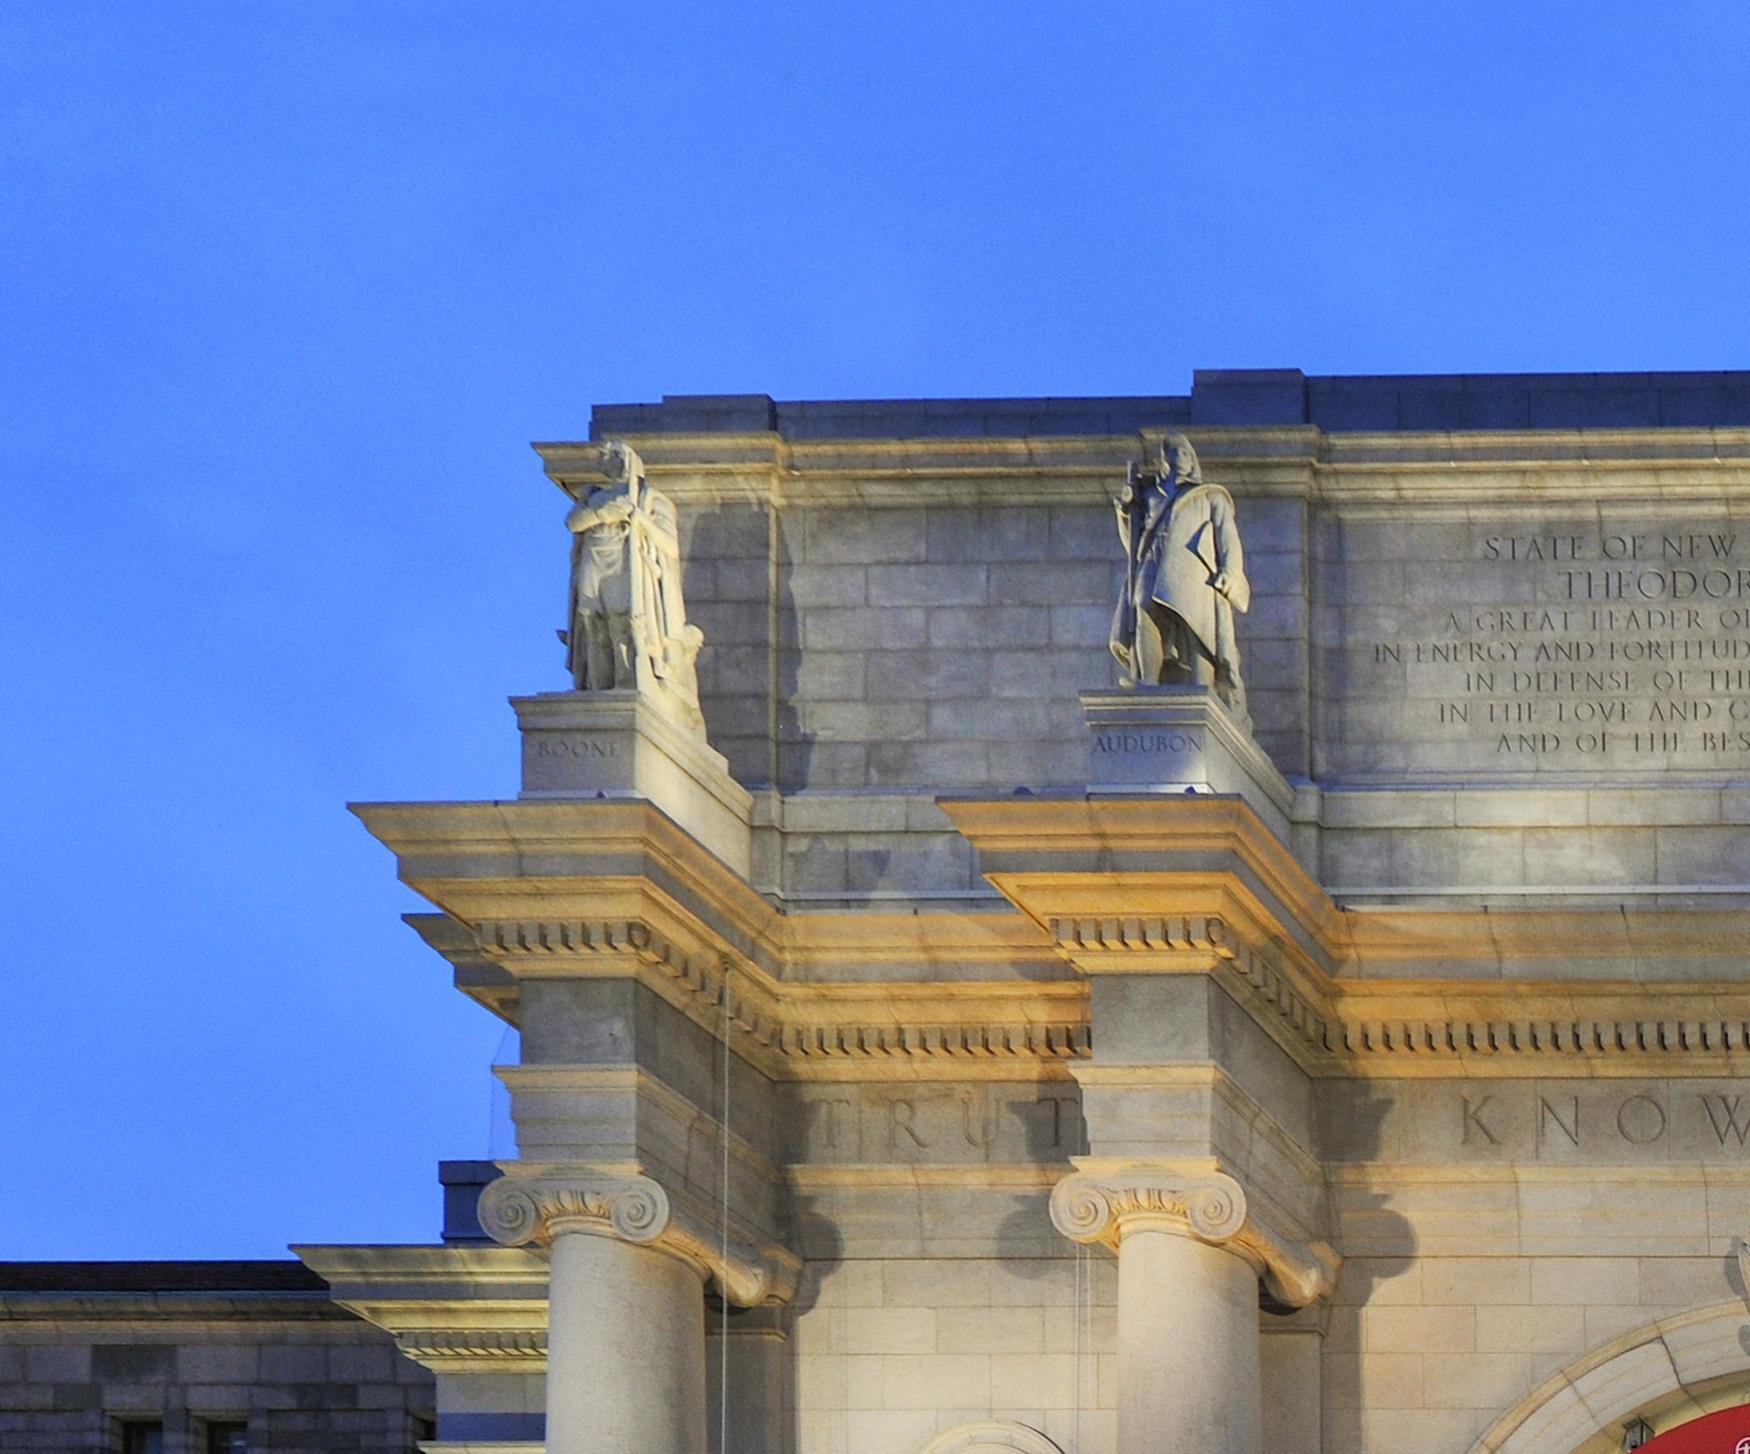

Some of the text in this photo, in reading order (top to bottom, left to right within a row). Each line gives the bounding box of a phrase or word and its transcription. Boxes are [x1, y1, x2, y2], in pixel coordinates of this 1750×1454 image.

[1484, 536, 1584, 560] STATE
[1602, 536, 1646, 560] OF
[1662, 534, 1736, 558] NEW
[1445, 612, 1461, 632] A
[1476, 611, 1573, 632] GREAT
[1591, 609, 1702, 630] LEADER
[1375, 644, 1400, 662] IN
[1416, 643, 1521, 662] ENERGY
[1536, 642, 1594, 661] AND
[1467, 672, 1494, 691] IN
[1513, 671, 1635, 691] DEFENSE
[1653, 671, 1687, 691] OF
[1440, 703, 1468, 723] IN
[1487, 702, 1537, 722] THE
[1558, 702, 1631, 722] LOVE
[1650, 701, 1712, 721] AND
[1095, 735, 1202, 752] AUDUBON
[1497, 733, 1560, 752] AND
[1576, 733, 1610, 752] OF
[1633, 731, 1681, 752] THE
[806, 1098, 1080, 1148] TRUT
